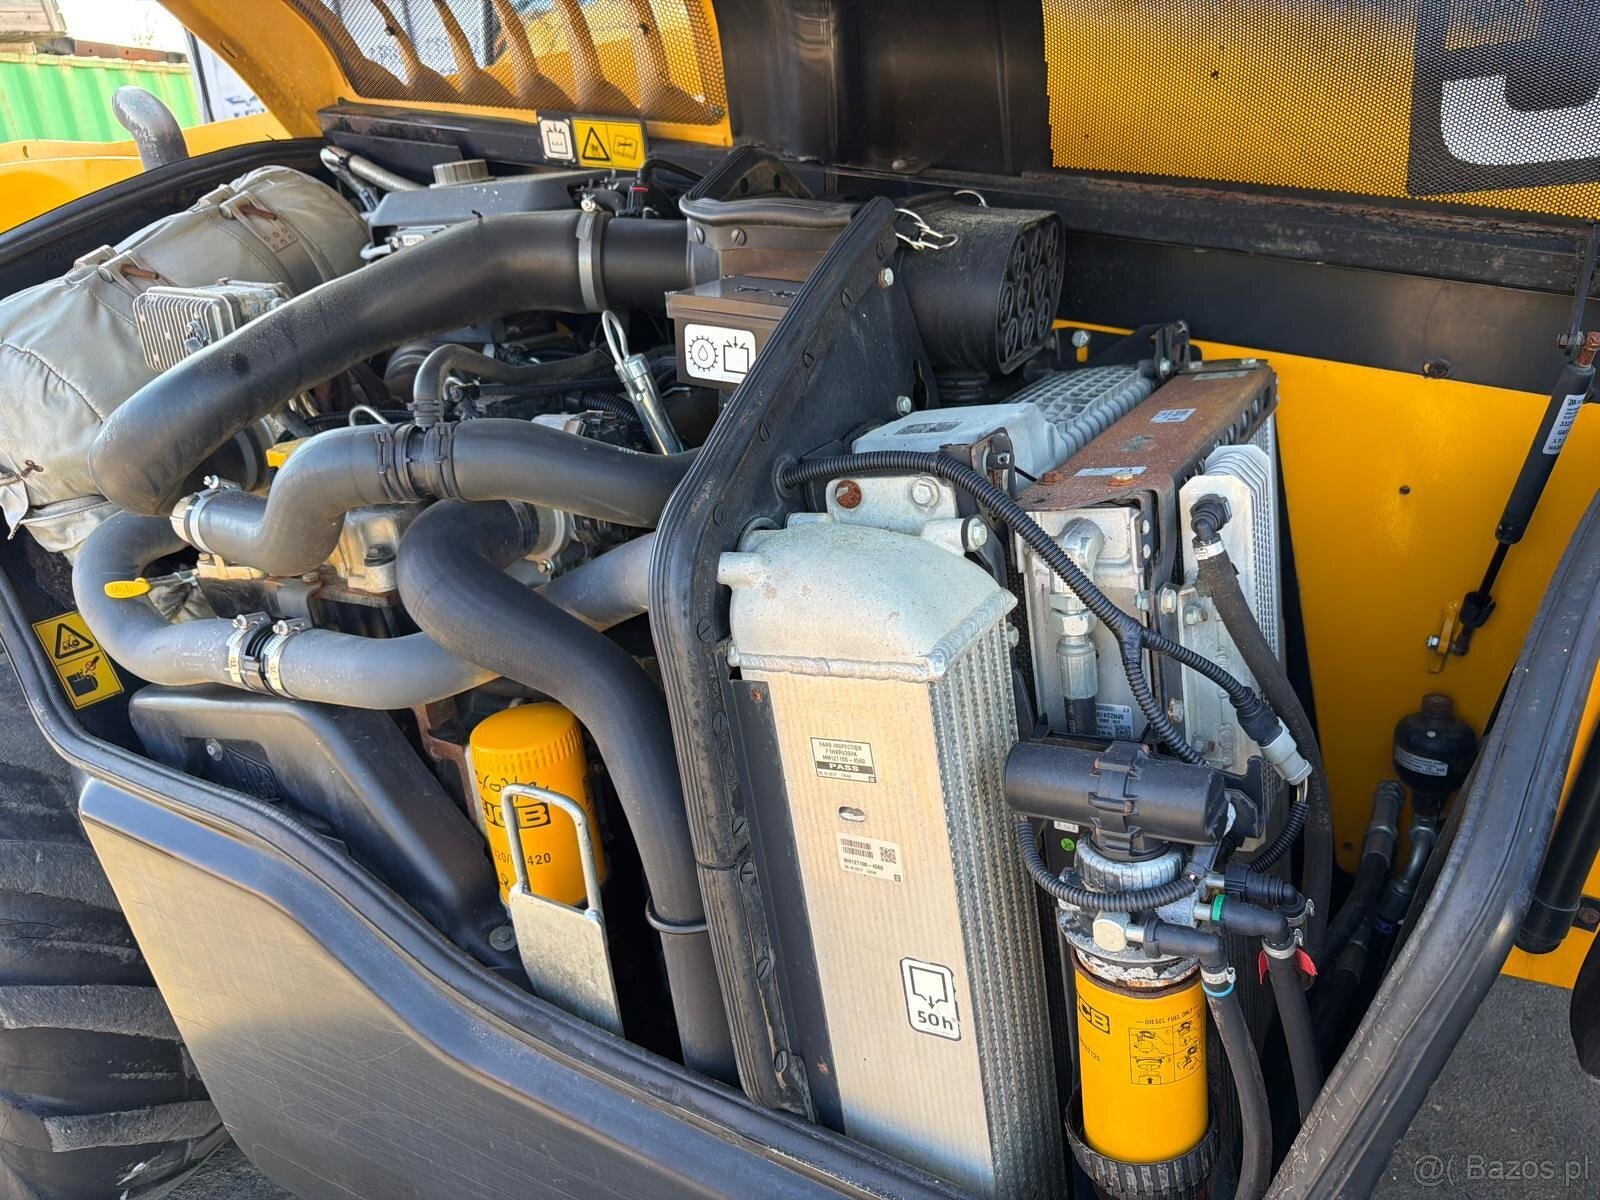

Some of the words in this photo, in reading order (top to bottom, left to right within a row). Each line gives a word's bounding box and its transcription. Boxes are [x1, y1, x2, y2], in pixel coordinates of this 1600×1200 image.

[829, 763, 860, 772] PASS
[1077, 993, 1110, 1035] CB
[1167, 1014, 1181, 1022] FUEL
